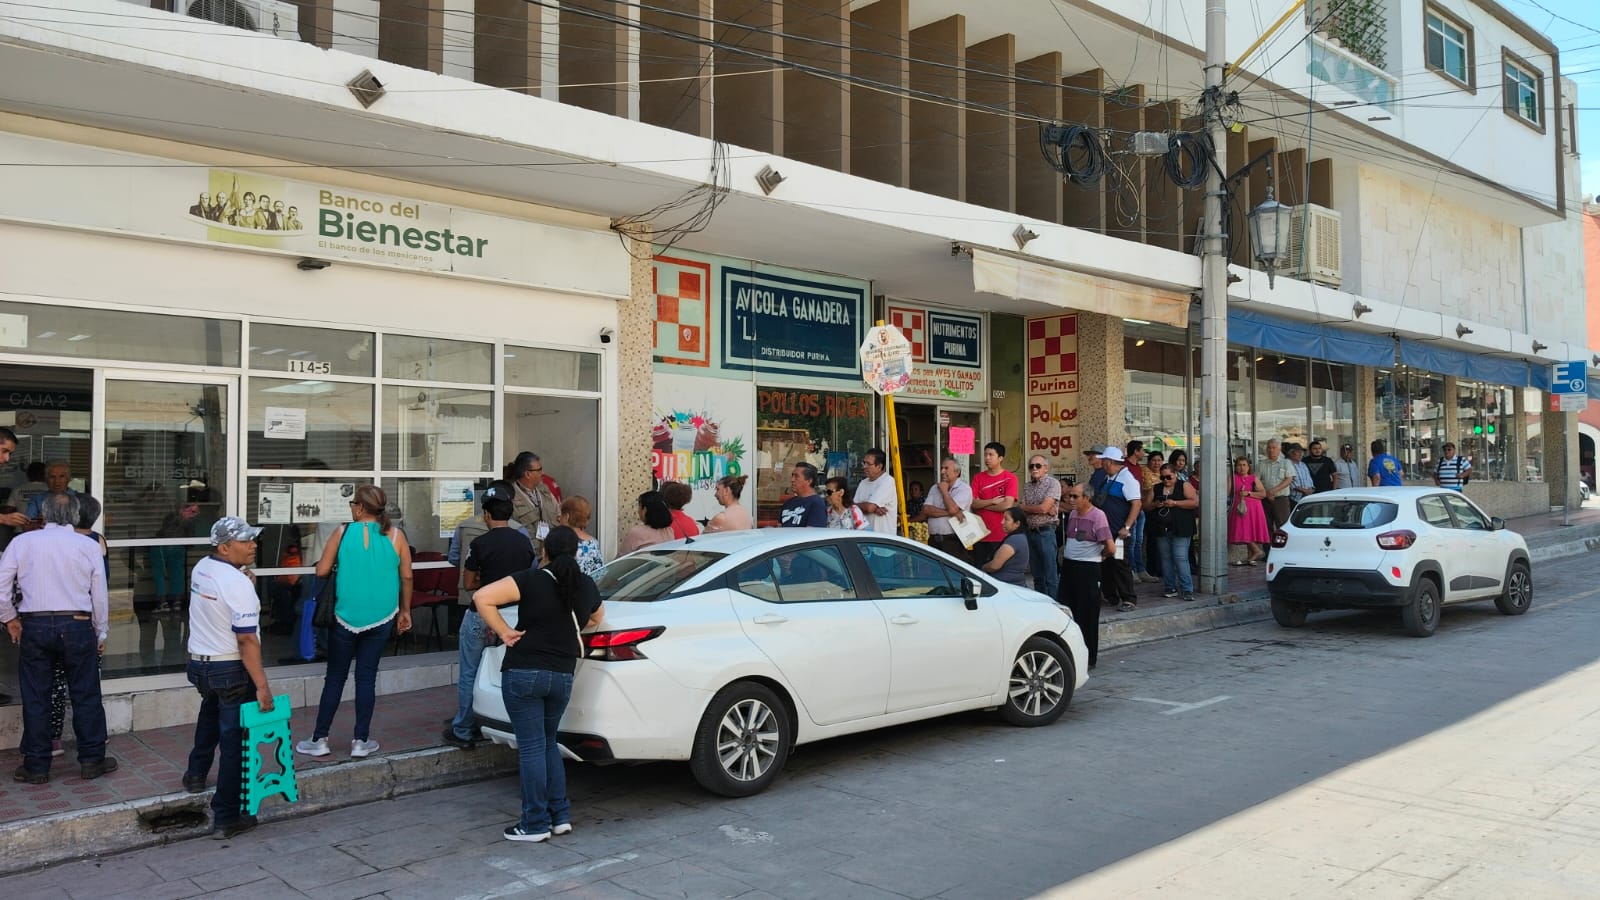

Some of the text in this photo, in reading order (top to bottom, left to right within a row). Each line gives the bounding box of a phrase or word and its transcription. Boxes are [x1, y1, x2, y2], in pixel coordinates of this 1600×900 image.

[319, 190, 420, 220] Banco del
[319, 208, 488, 258] Bienestar
[318, 241, 433, 262] El banco de los mexicanos
[735, 287, 850, 325] AVICOLA GANADERA
[933, 321, 977, 339] NUTRIMENTOS
[761, 347, 830, 362] DISTRIBUIDOR PURINA
[943, 342, 967, 356] PURINA
[290, 361, 330, 374] 114-5
[957, 370, 981, 381] GANADO
[1552, 363, 1570, 385] E
[945, 379, 974, 391] POLLITOS
[1030, 378, 1076, 393] Purina
[9, 393, 68, 408] CAJA 2
[759, 391, 868, 418] POLLOS ROGA
[1030, 401, 1078, 425] Pollos
[1030, 431, 1072, 457] Roga
